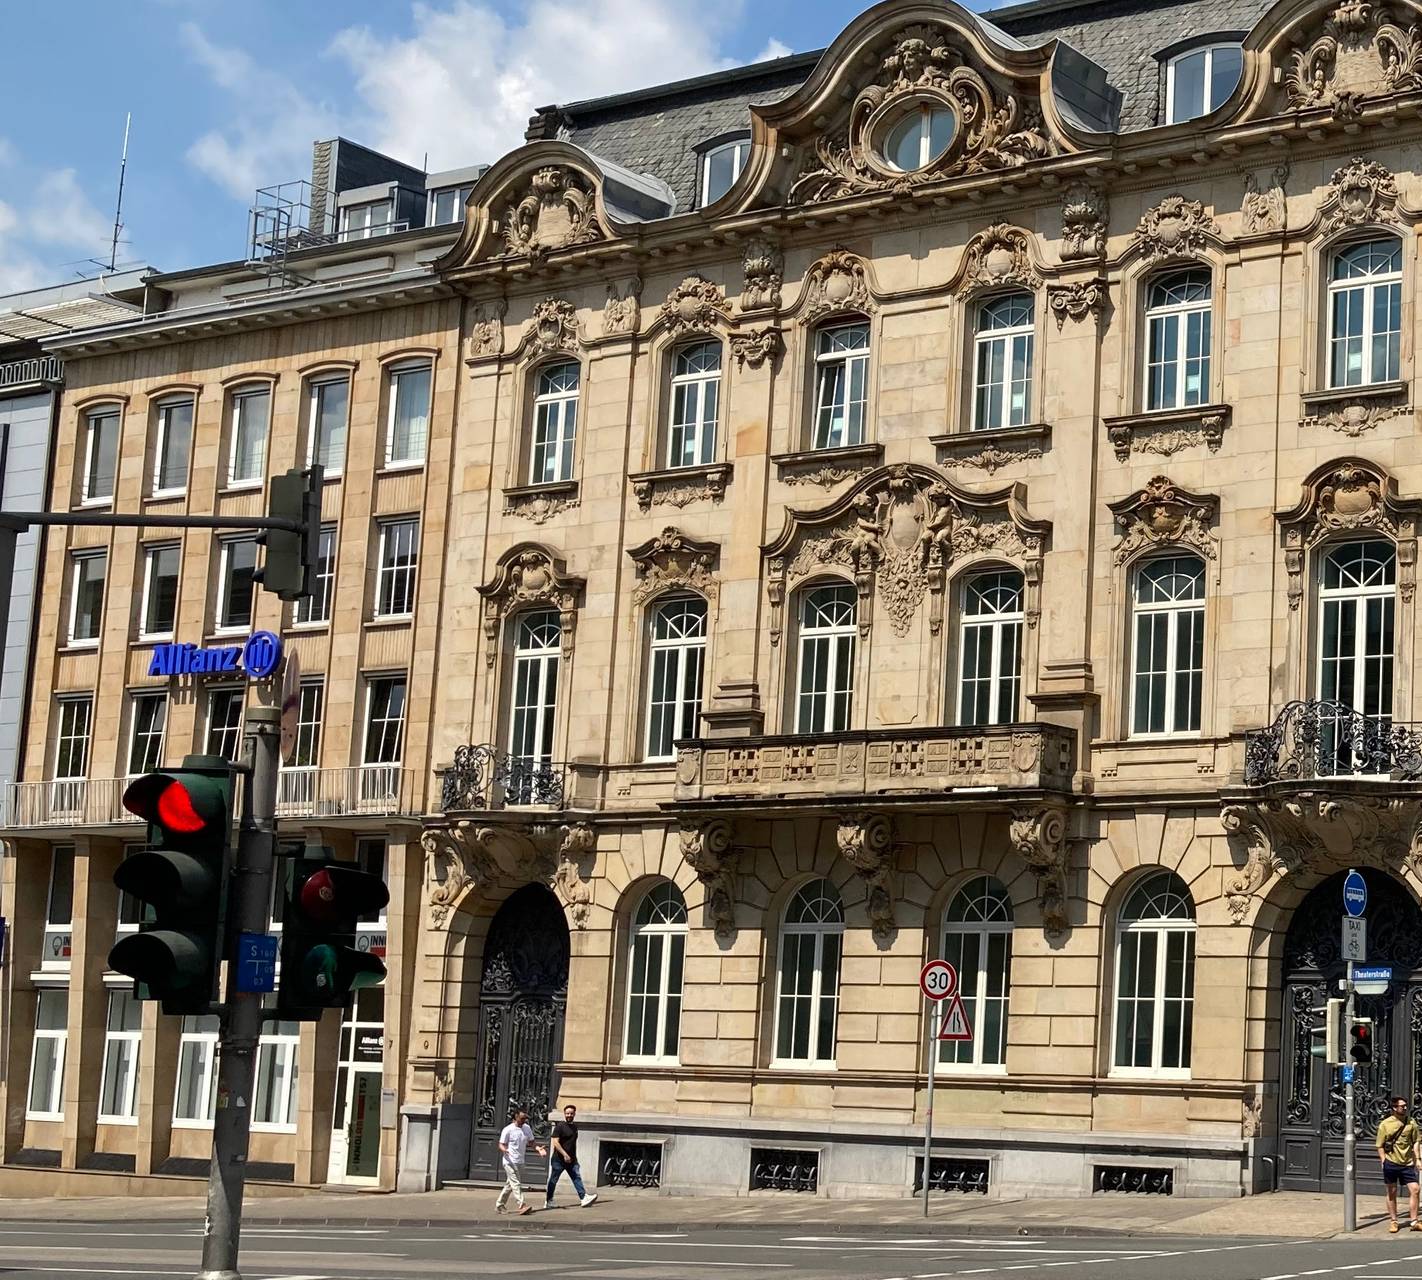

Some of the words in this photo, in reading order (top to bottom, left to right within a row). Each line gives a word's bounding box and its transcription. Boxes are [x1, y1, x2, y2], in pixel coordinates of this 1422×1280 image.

[148, 642, 243, 676] Allianz
[1348, 920, 1361, 931] TAXI
[928, 971, 948, 990] 30
[1354, 970, 1390, 978] Theaterstraße
